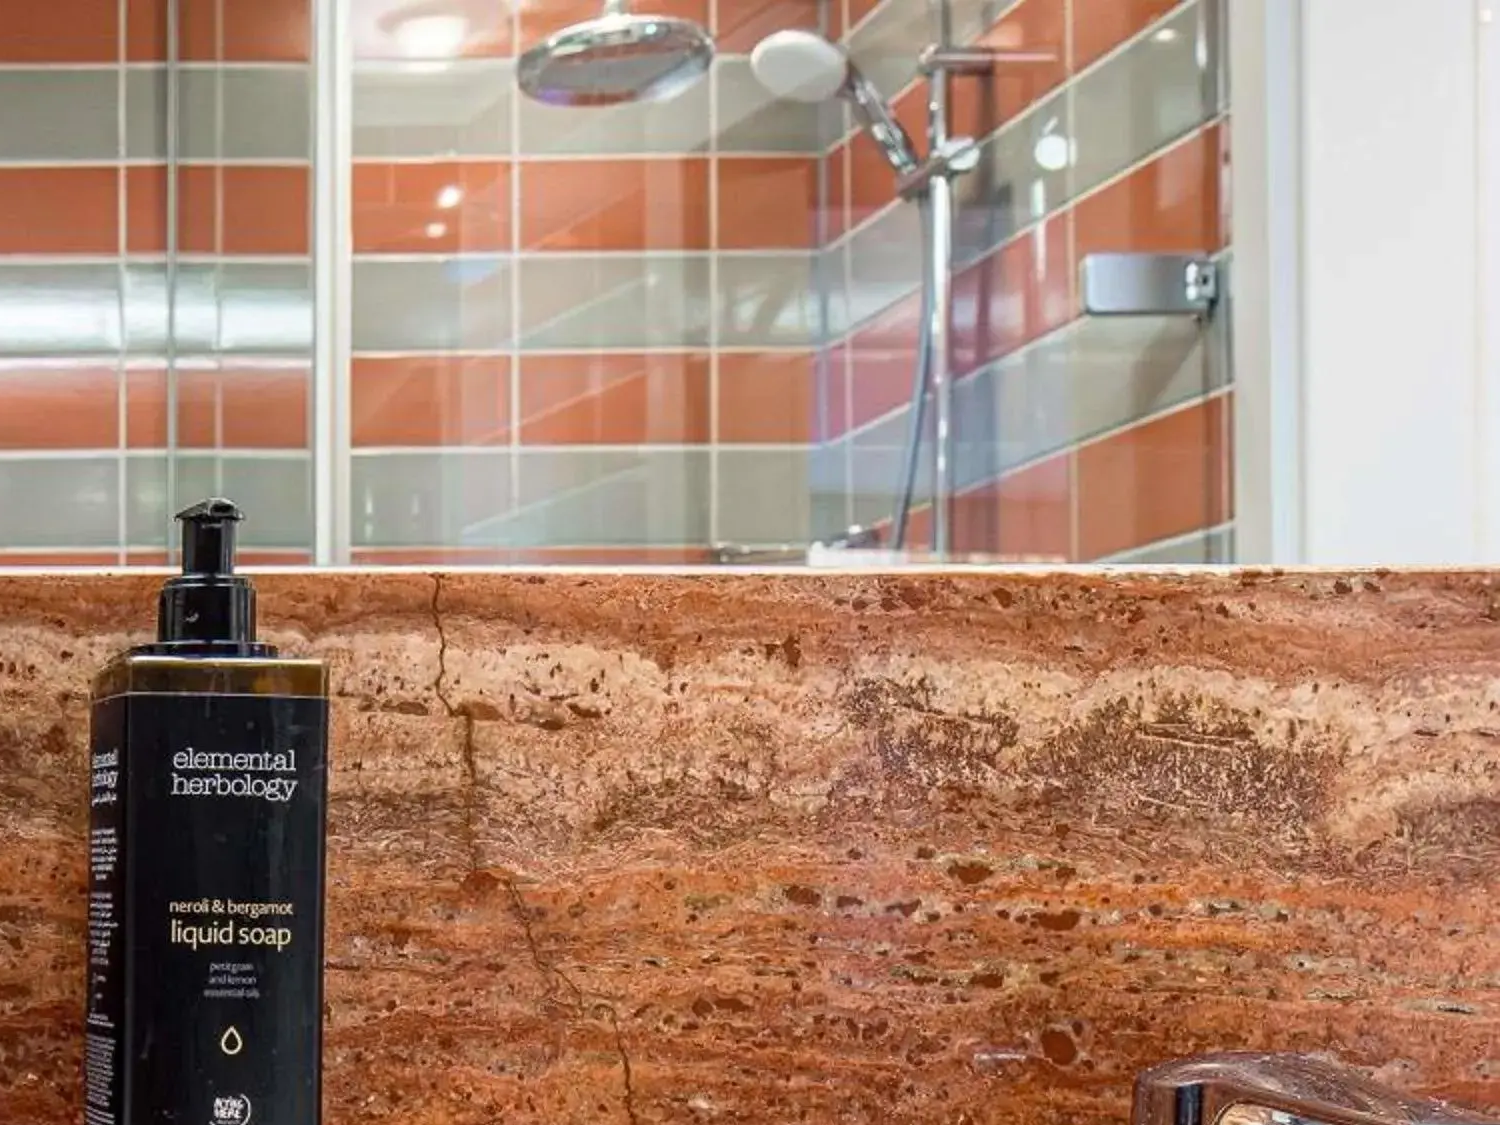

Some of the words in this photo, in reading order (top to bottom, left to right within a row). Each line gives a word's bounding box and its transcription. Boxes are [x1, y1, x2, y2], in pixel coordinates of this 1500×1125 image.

[173, 748, 297, 771] elemental
[170, 773, 298, 801] herbology
[169, 899, 209, 913] neroli
[211, 900, 225, 913] &
[227, 900, 294, 918] bergamot
[170, 919, 233, 951] liquid
[238, 927, 291, 952] soap
